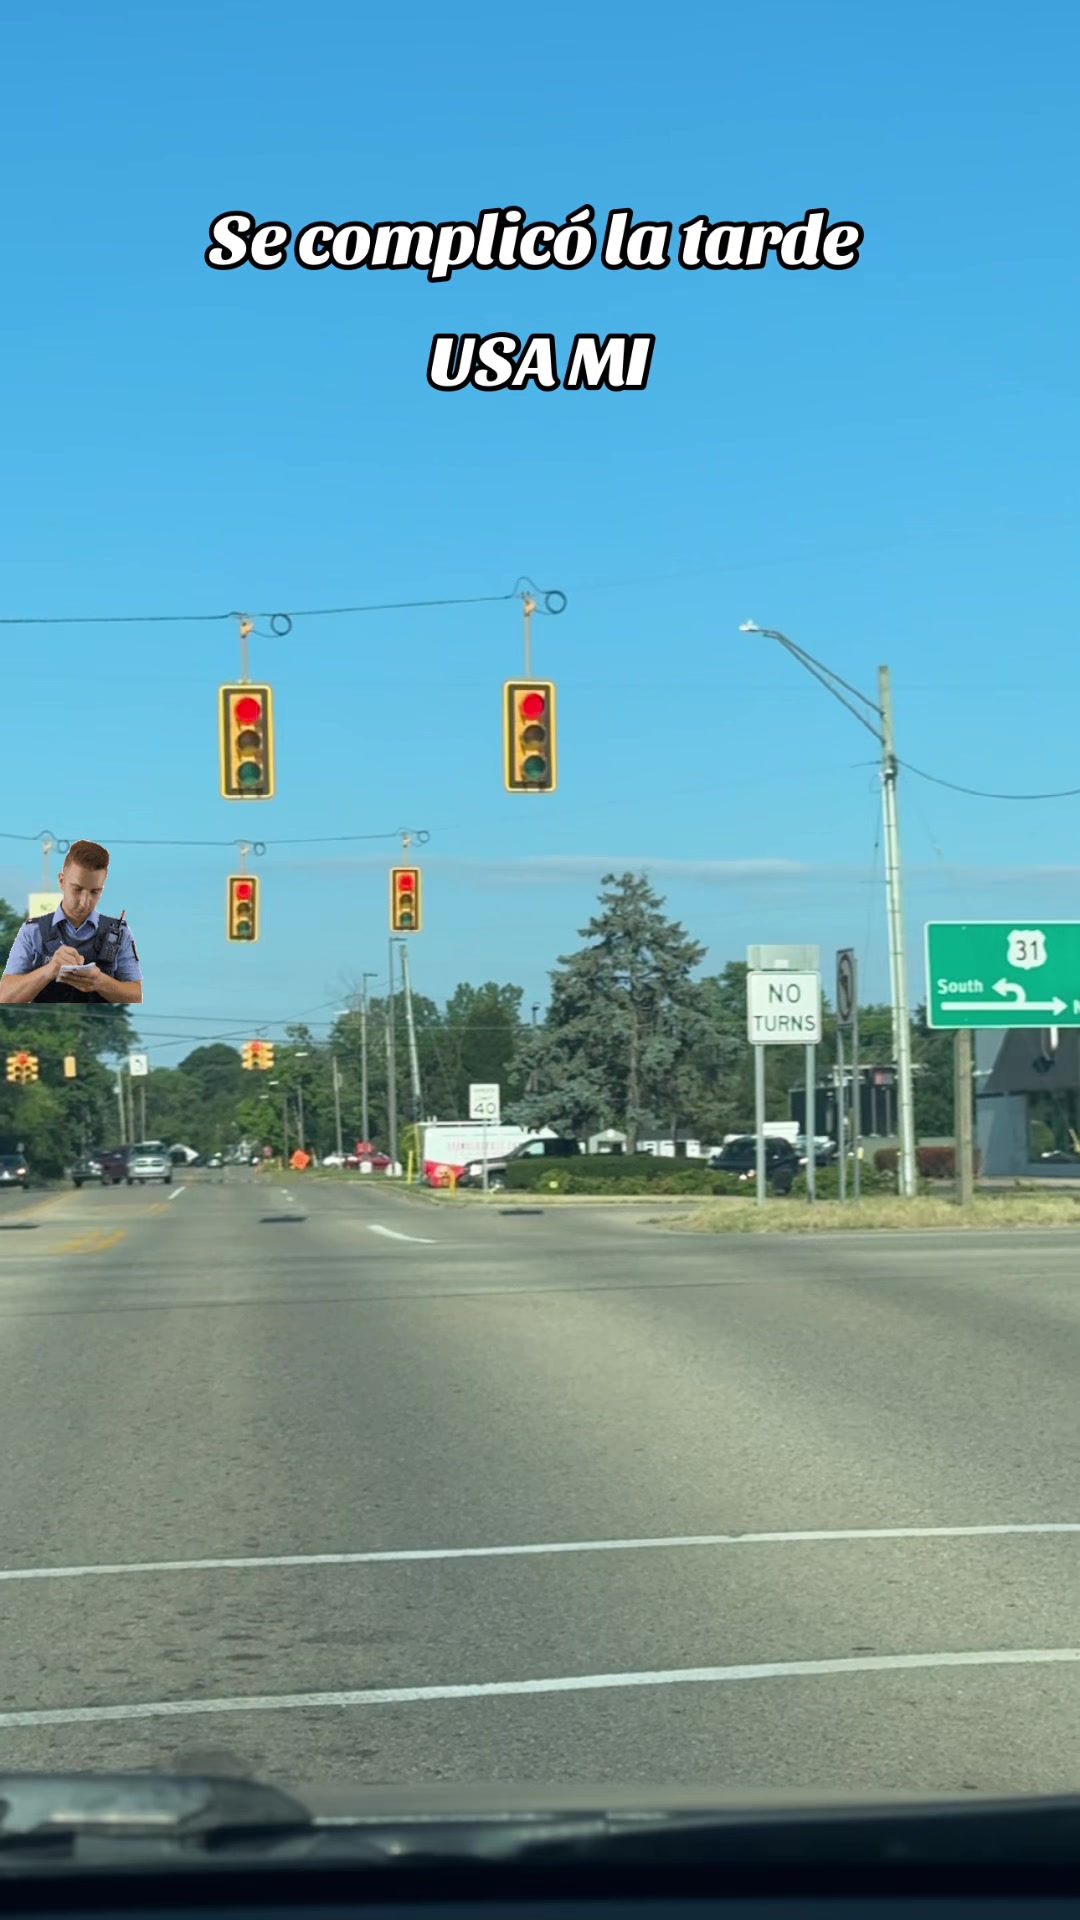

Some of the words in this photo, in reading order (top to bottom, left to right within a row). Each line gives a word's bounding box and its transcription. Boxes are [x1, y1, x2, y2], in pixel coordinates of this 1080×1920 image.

[1015, 939, 1038, 961] 31
[768, 983, 801, 1003] NO
[937, 978, 984, 994] South
[754, 1015, 816, 1031] TURNS
[474, 1102, 497, 1115] 40
